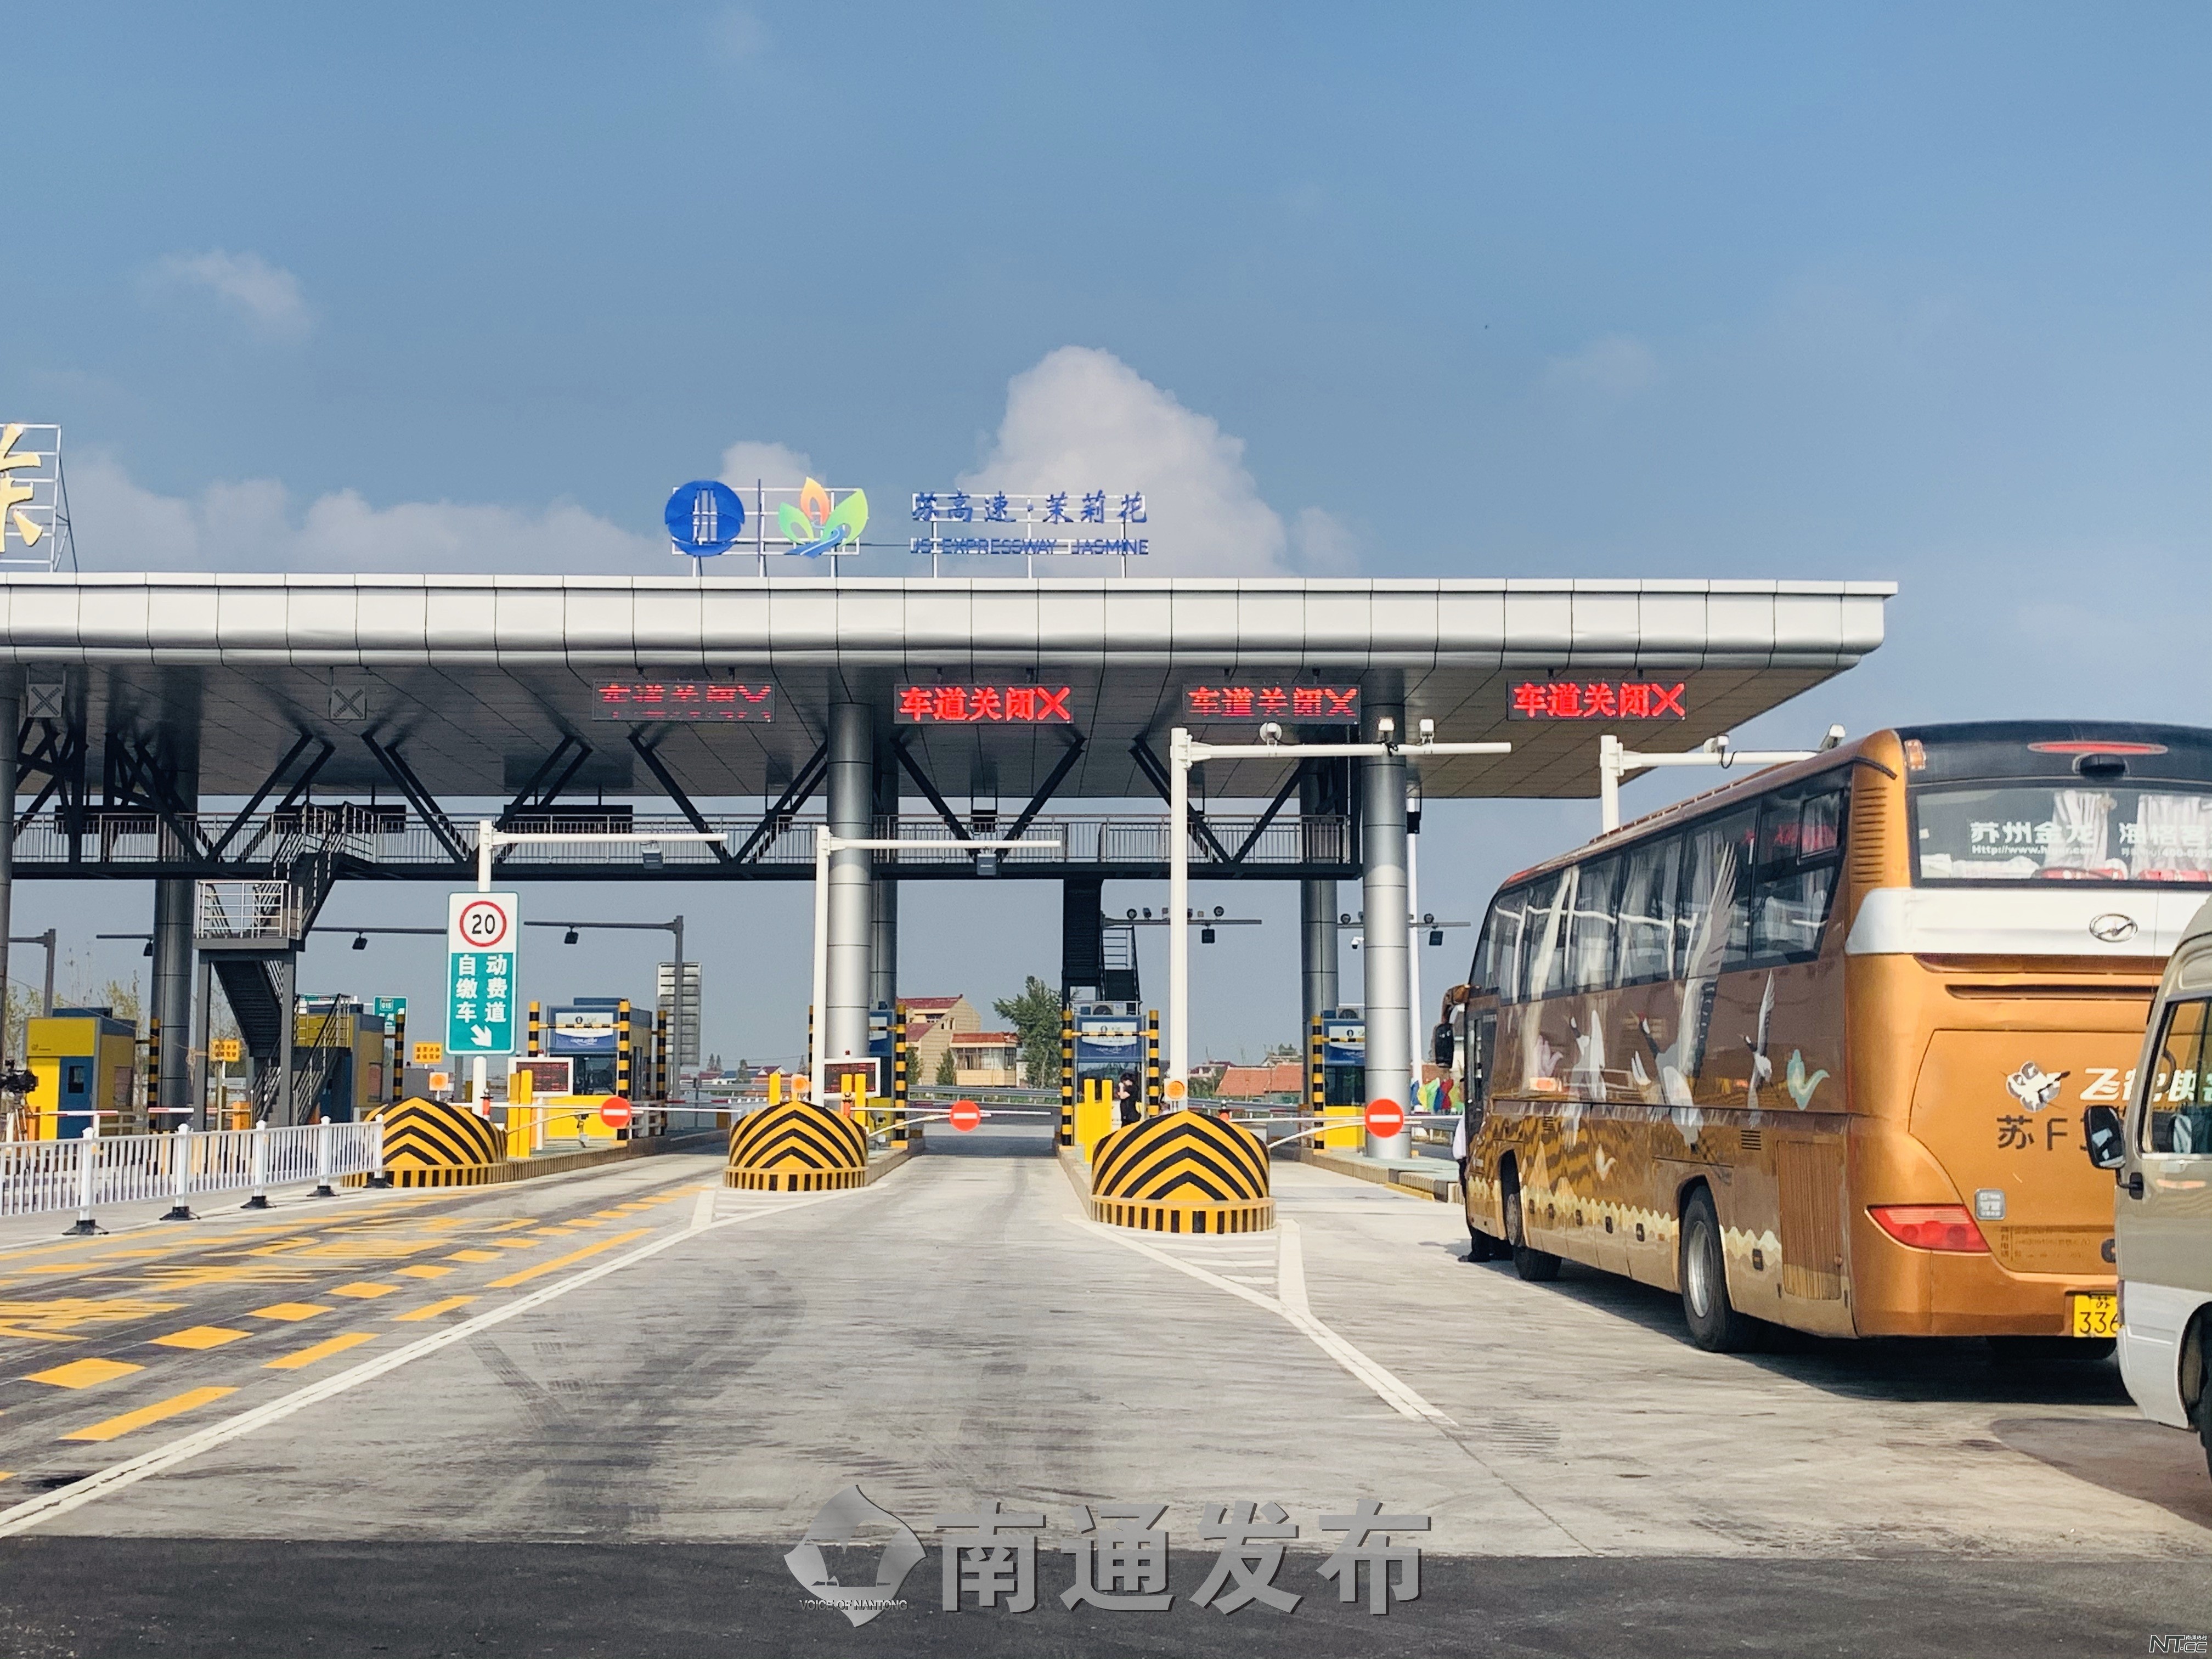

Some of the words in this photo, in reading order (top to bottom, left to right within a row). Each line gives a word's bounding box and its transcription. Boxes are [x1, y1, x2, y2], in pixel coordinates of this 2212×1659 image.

[942, 539, 1057, 555] EXPRESSWAY
[1075, 539, 1149, 555] JASMINE
[1970, 821, 2095, 844] 苏州金龙
[2118, 822, 2212, 845] 海格客
[471, 914, 495, 935] 20
[1996, 1115, 2087, 1151] 苏F
